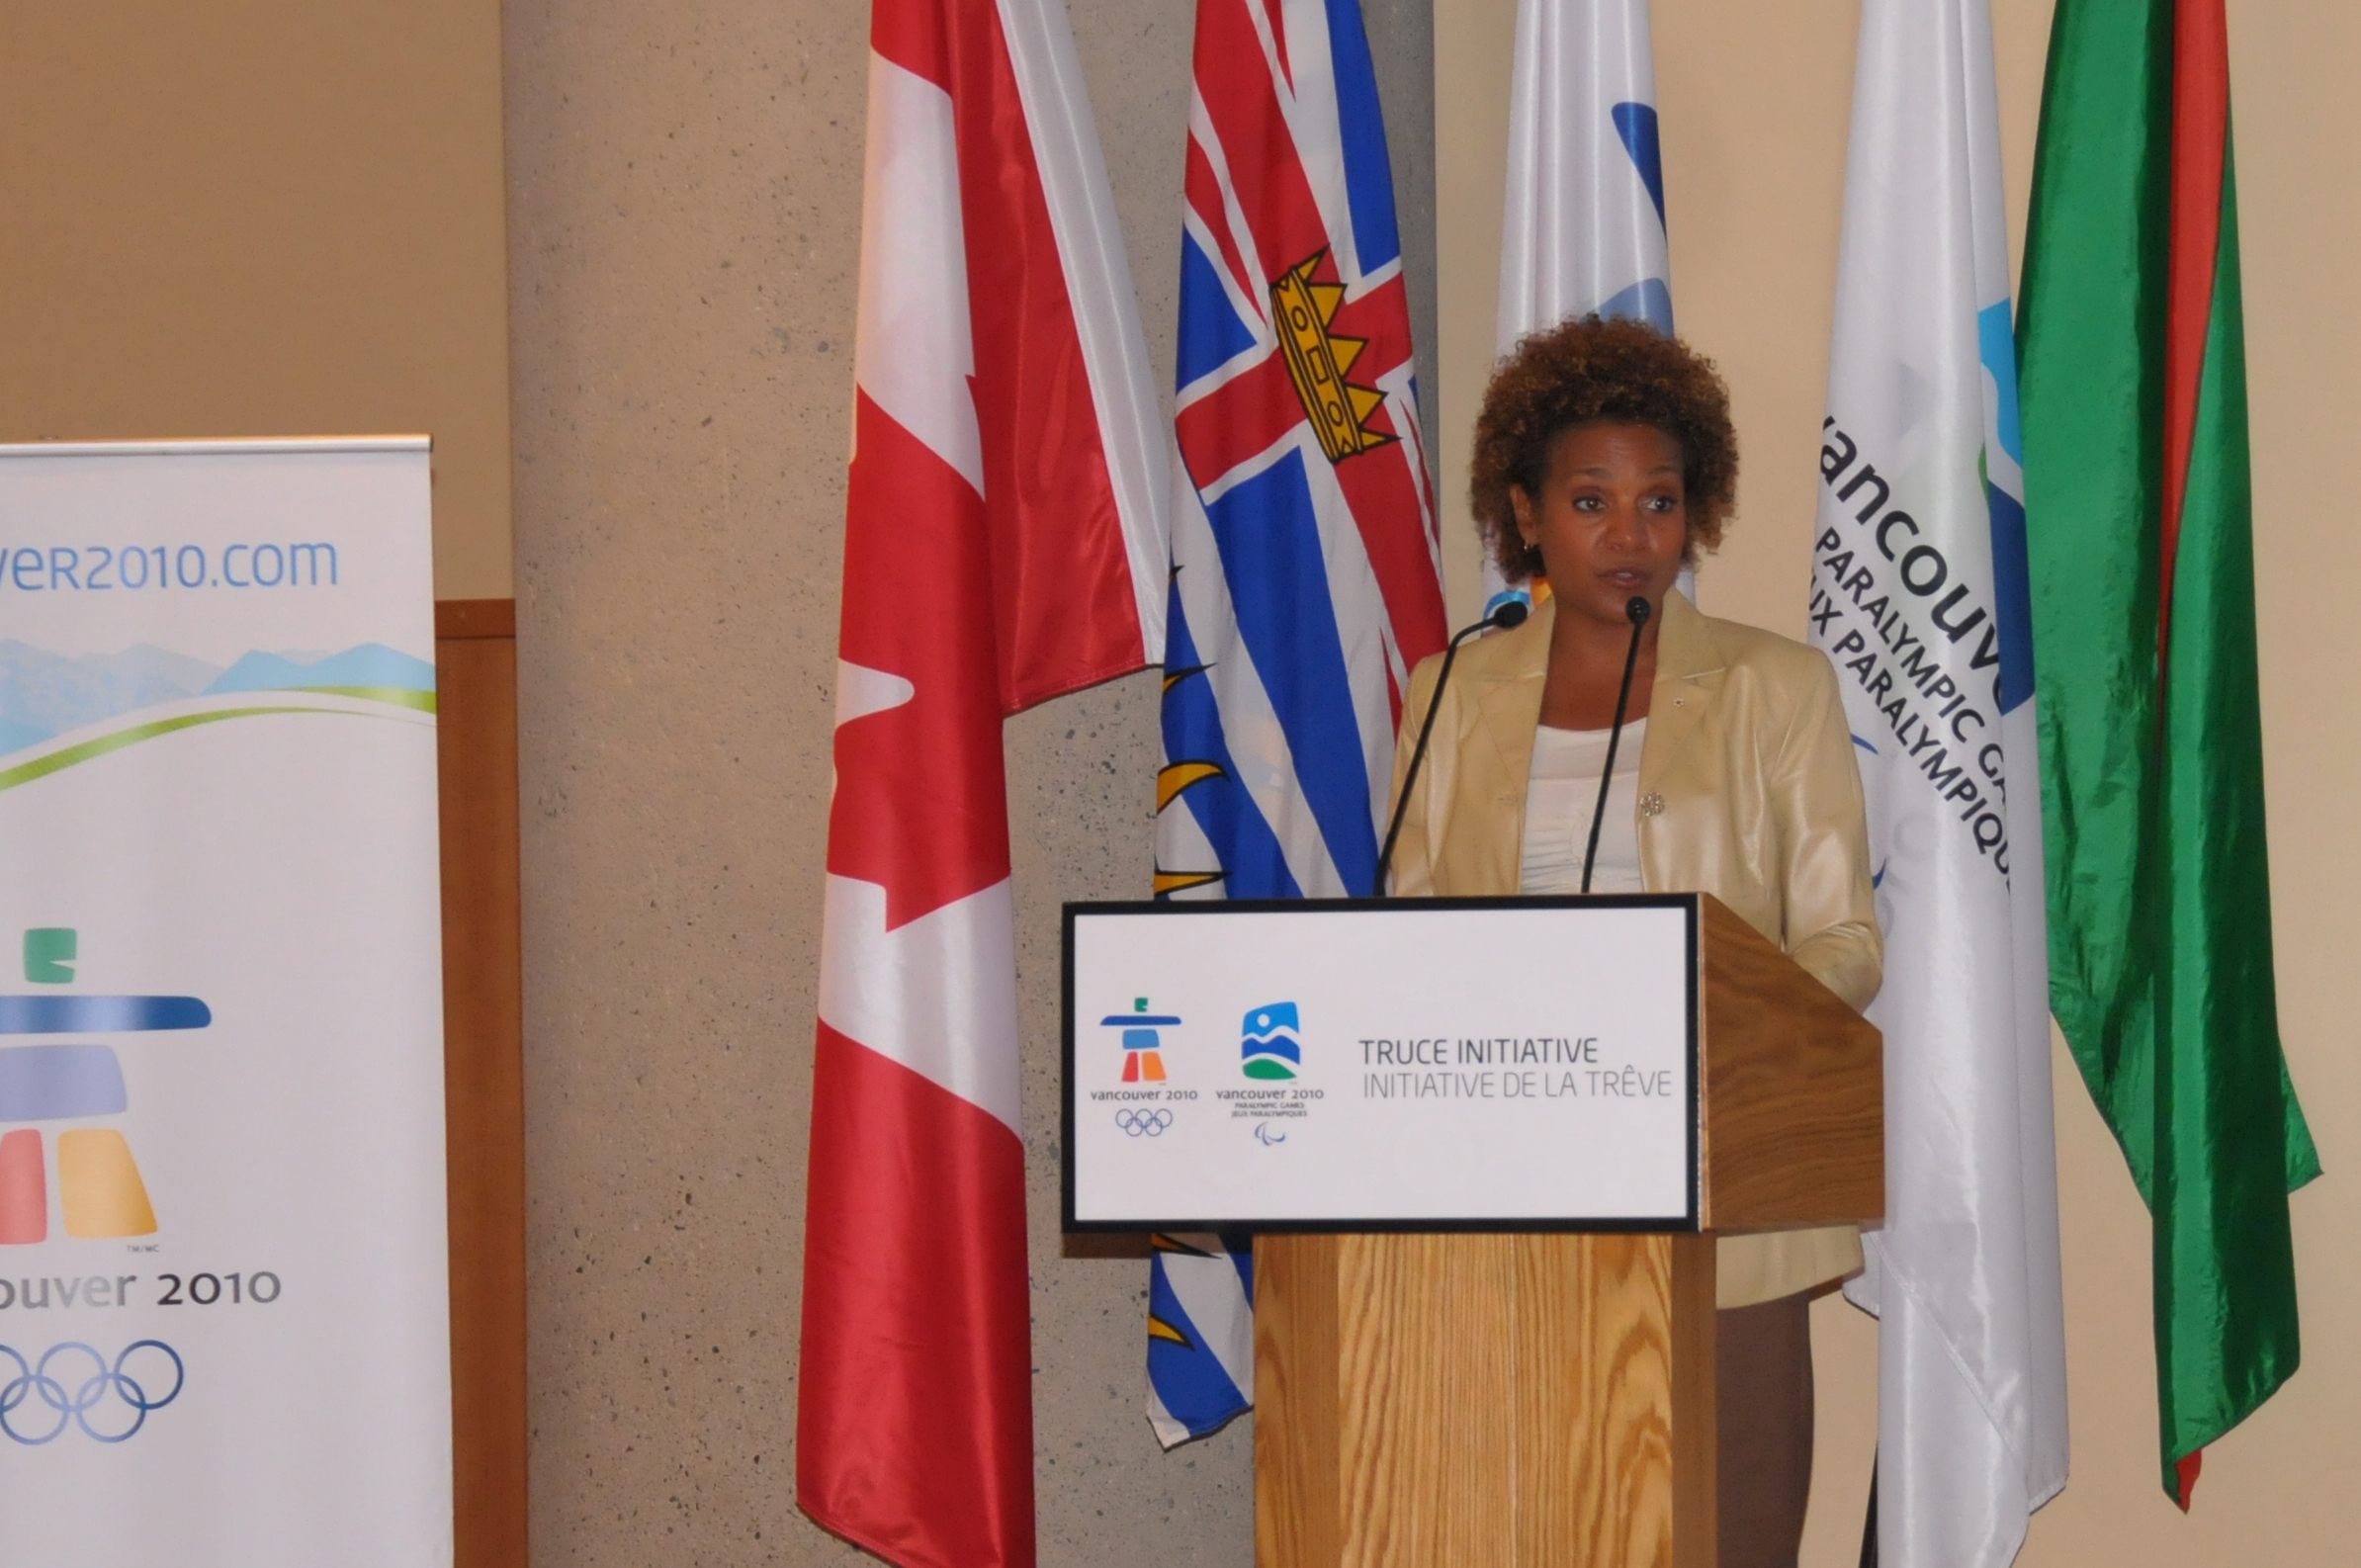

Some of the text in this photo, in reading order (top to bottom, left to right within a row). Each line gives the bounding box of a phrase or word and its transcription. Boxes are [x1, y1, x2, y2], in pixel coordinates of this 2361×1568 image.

[1820, 415, 2004, 716] ancouv
[1815, 526, 1985, 743] PARALYMPIC
[1831, 628, 2011, 893] PARALYMPIQU
[1358, 1037, 1598, 1065] TRUCE INITIATIVE
[1091, 1089, 1198, 1101] vancouver 2010
[1215, 1089, 1325, 1100] vancouver 2010
[1363, 1064, 1672, 1098] INITIATIVE DE LA TRÊVE
[156, 1271, 282, 1306] 2010
